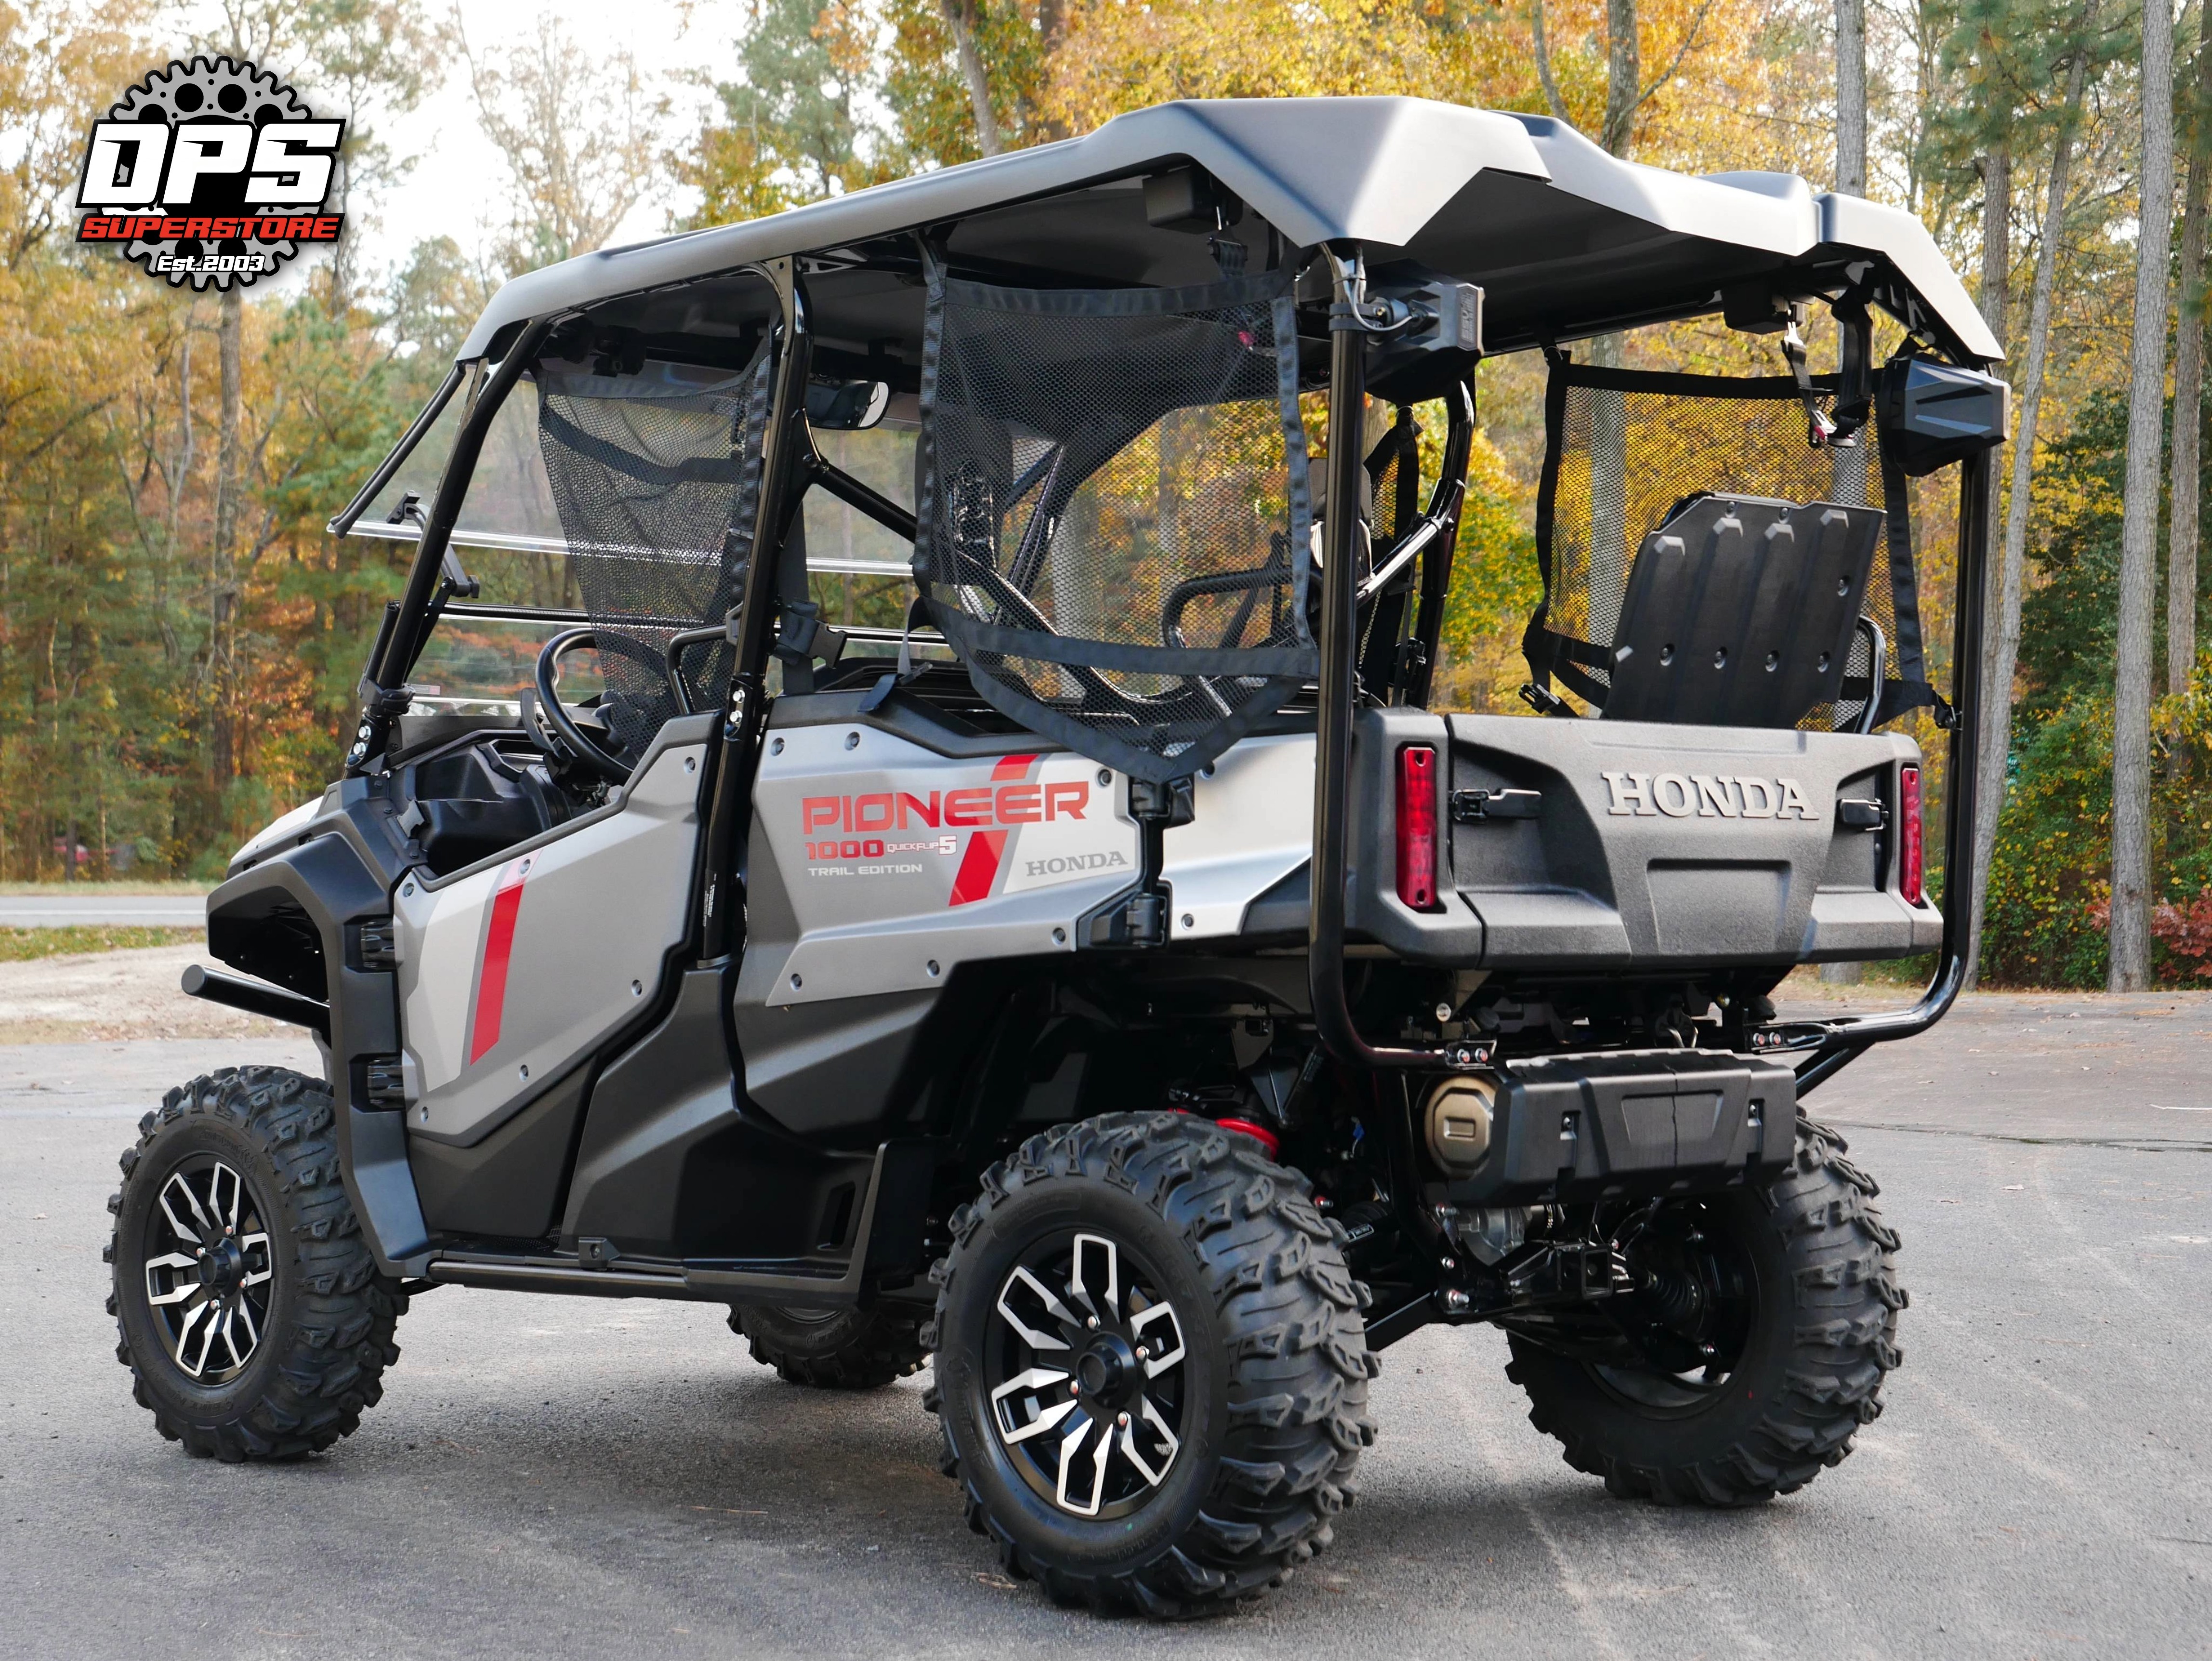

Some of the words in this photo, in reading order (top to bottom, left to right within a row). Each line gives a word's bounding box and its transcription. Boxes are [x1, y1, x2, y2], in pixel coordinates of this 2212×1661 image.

[802, 781, 1089, 835] PIONEER
[1602, 772, 1820, 820] HONDA
[805, 840, 884, 860] 1000
[808, 867, 855, 876] TRAIL
[857, 864, 923, 874] EDITION
[1025, 851, 1128, 877] HONDA
